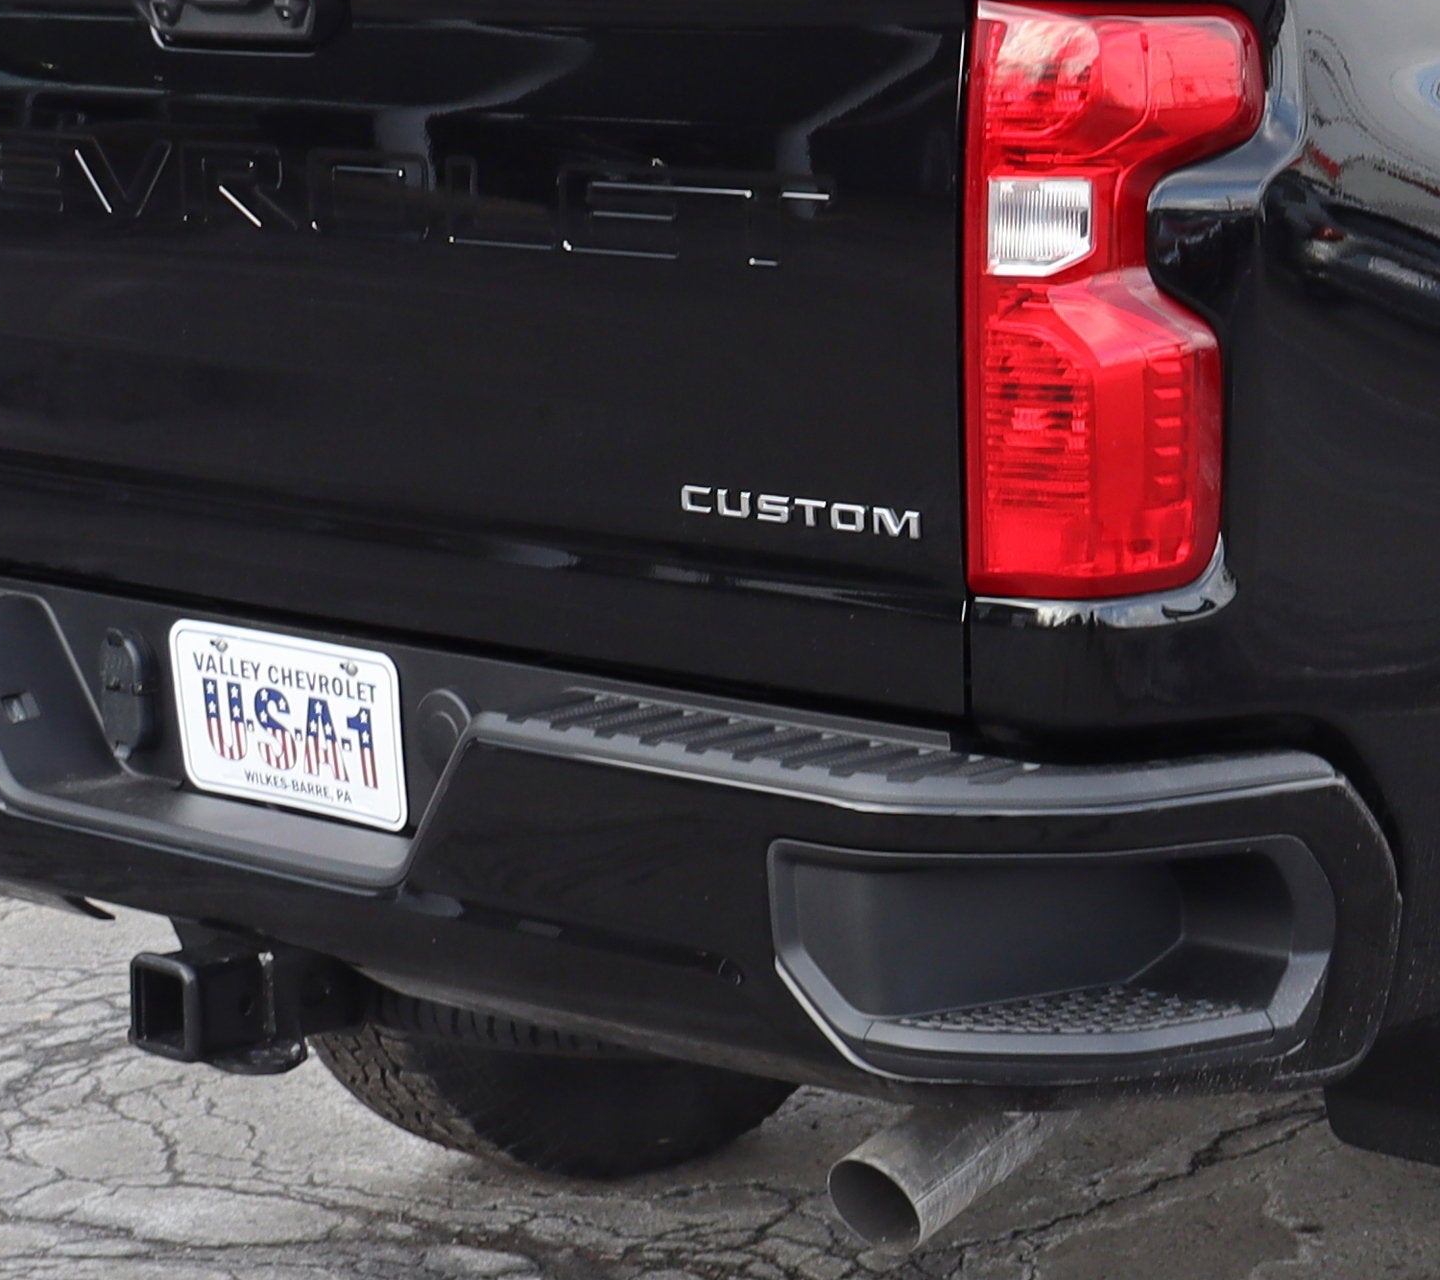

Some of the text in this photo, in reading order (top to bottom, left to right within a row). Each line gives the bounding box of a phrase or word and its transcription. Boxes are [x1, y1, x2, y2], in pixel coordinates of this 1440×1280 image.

[681, 484, 921, 539] CUSTOM
[193, 651, 377, 704] VALLEY CHEVROLET
[336, 790, 353, 803] PA
